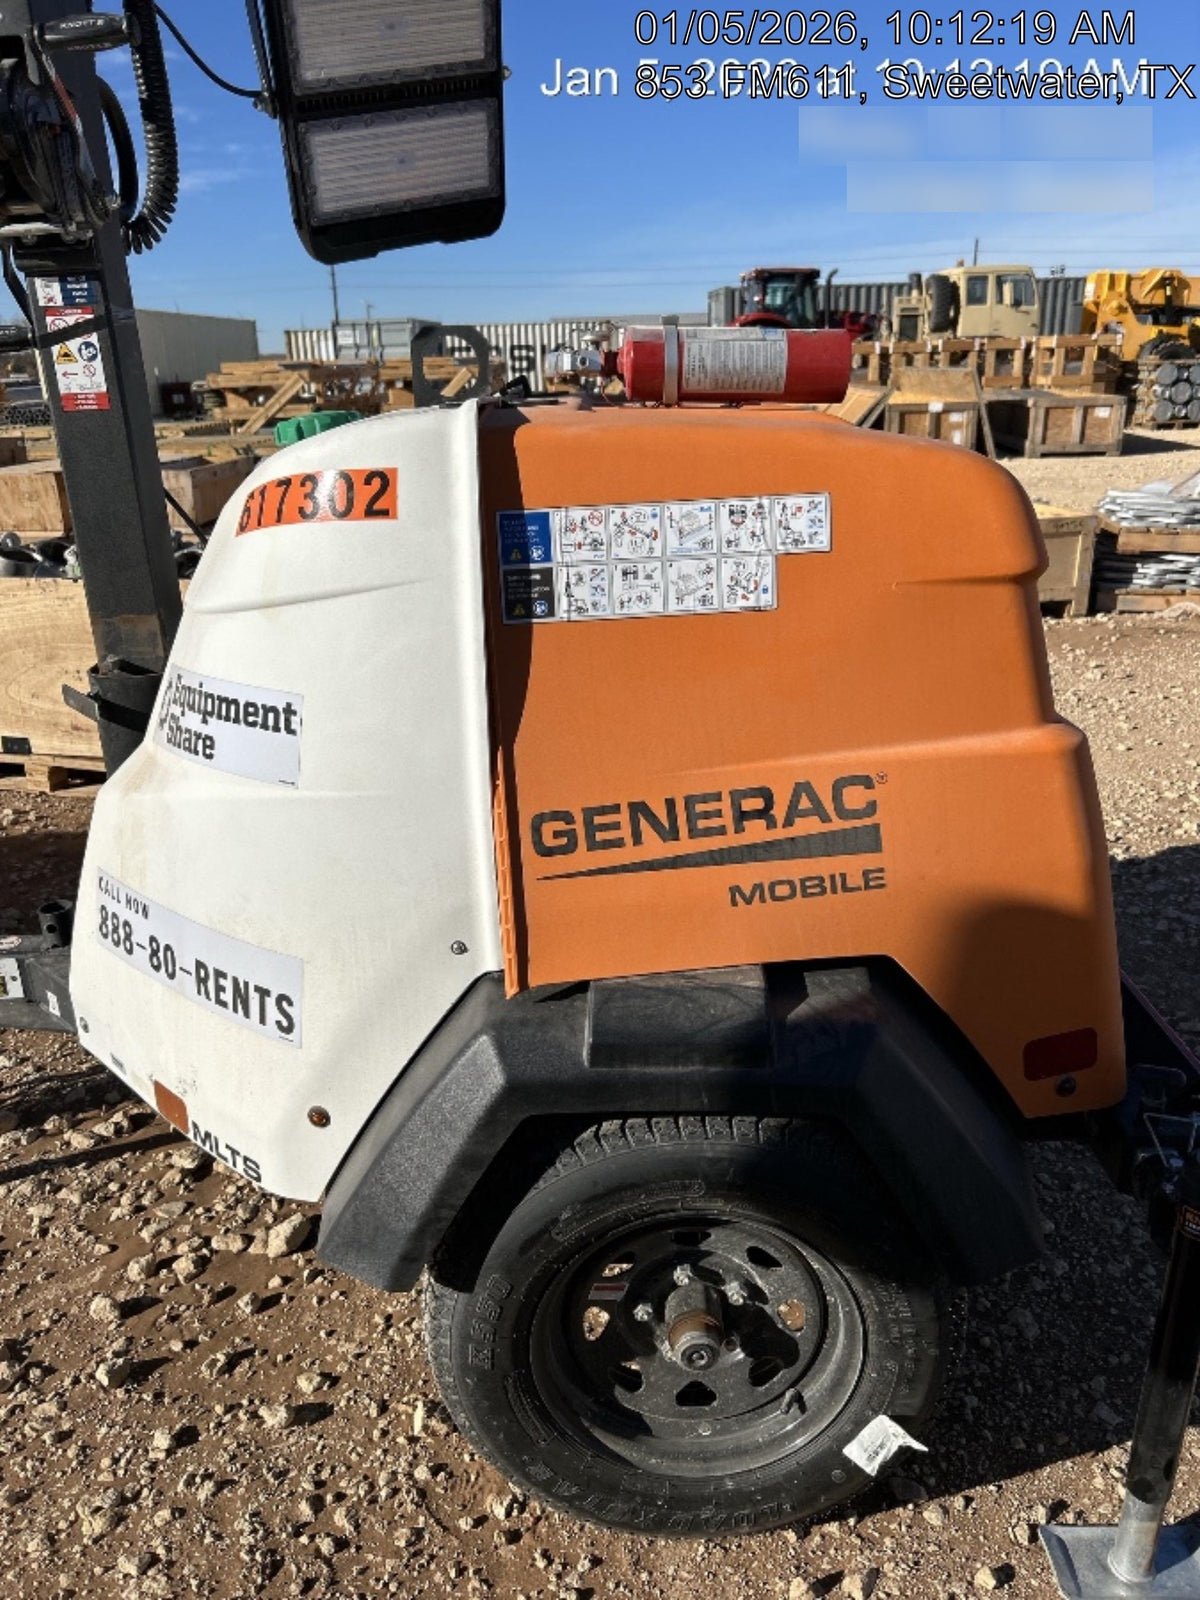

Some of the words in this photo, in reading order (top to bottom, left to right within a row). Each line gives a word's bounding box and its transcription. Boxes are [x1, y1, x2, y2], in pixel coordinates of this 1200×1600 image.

[239, 470, 390, 532] 617302
[166, 712, 216, 760] Share
[172, 674, 298, 736] Equipment
[530, 774, 878, 858] GENERAC
[98, 875, 122, 904] CALL
[728, 867, 887, 907] MOBILE
[98, 904, 296, 1035] 888-80-RENTS
[191, 1120, 263, 1184] MLTS
